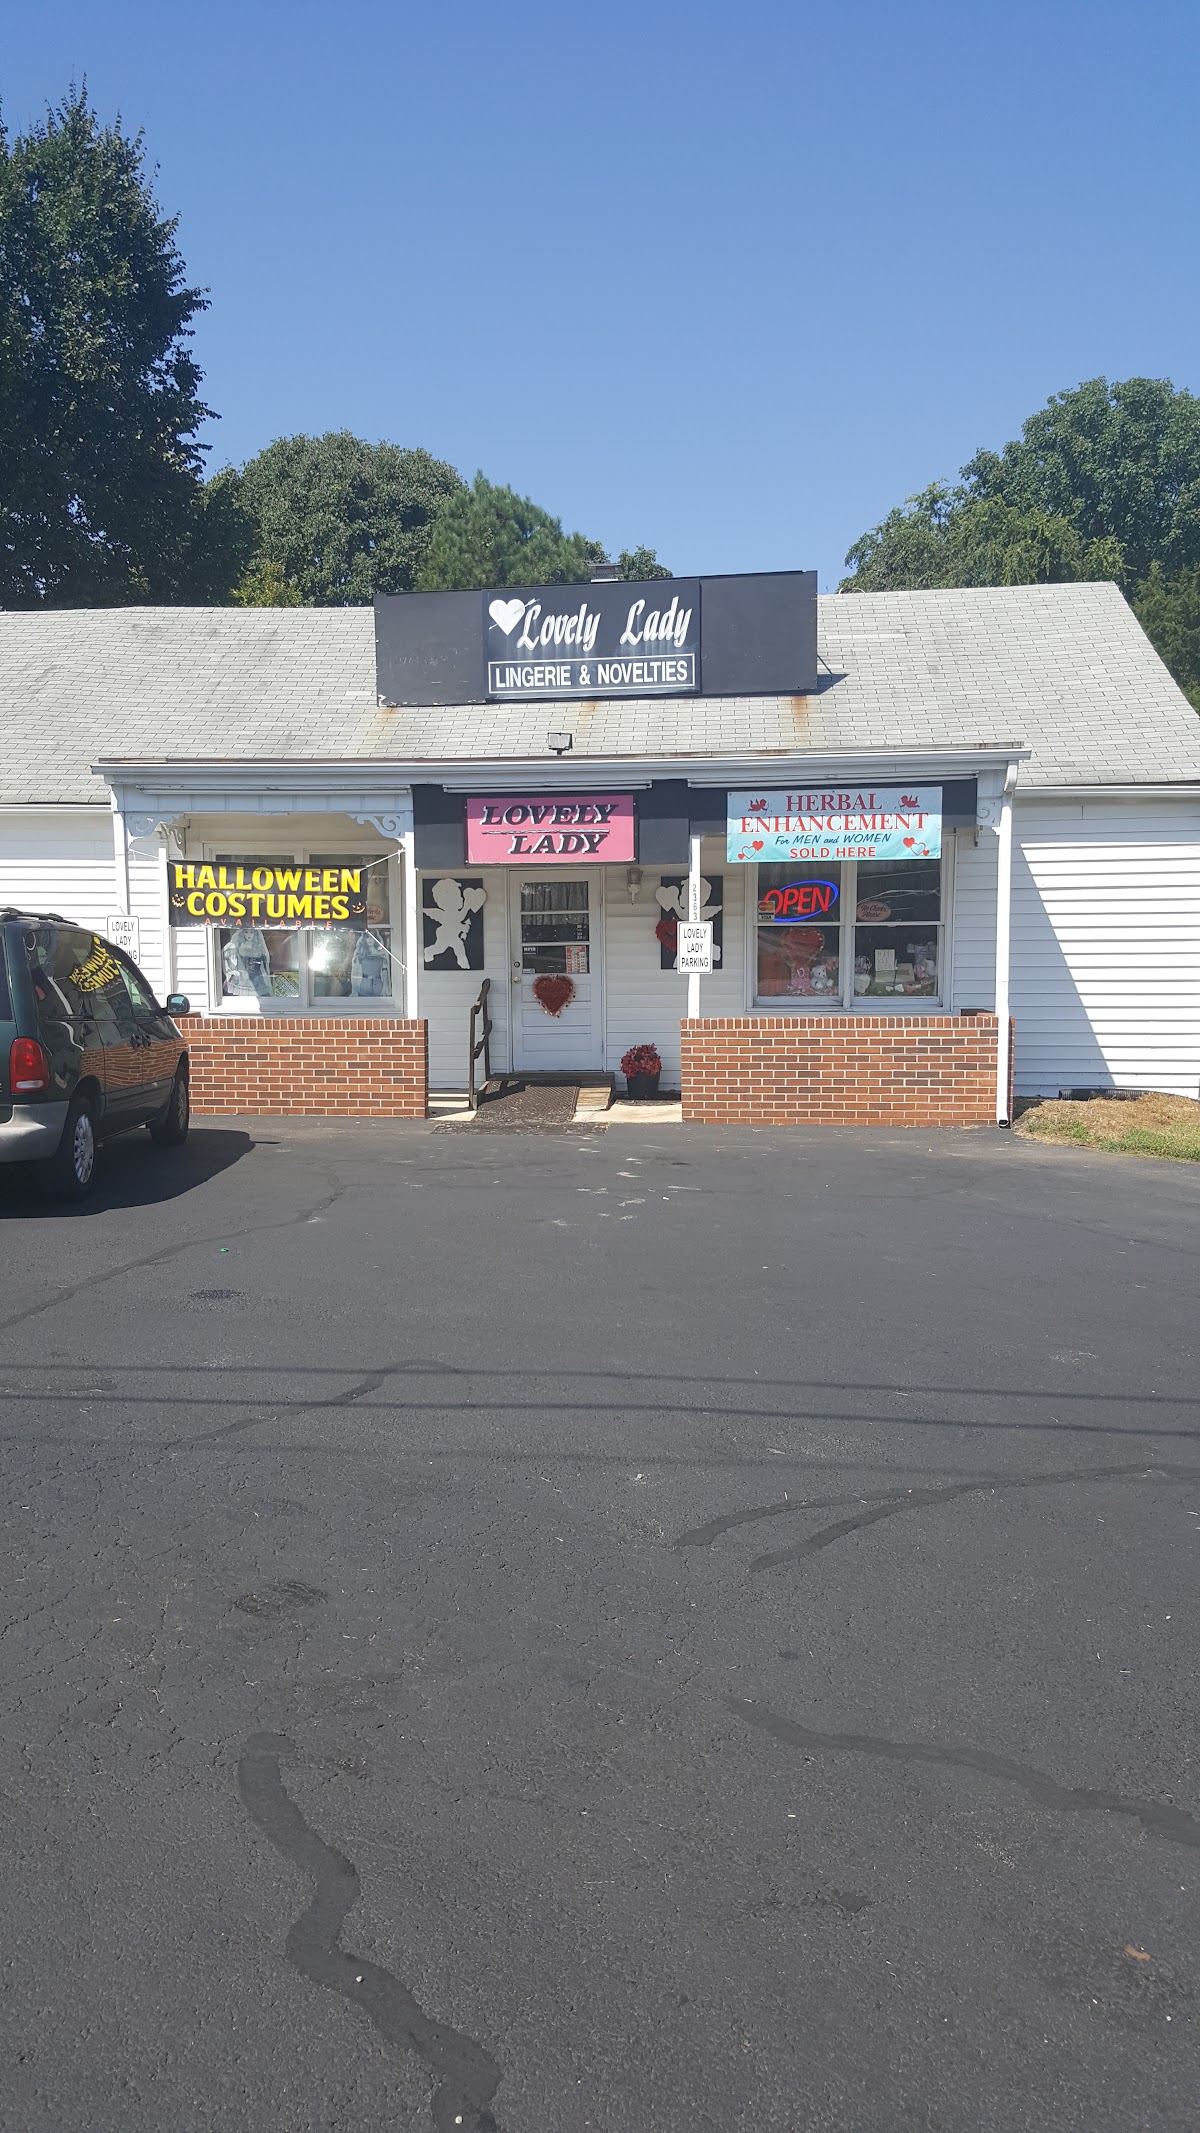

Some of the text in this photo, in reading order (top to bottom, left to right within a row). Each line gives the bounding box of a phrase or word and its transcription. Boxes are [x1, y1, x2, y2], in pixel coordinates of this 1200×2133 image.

[516, 596, 694, 652] Lovely Lady
[495, 660, 688, 689] LINGERIE & NOVELTIES
[785, 793, 883, 812] HERBAL
[481, 804, 618, 825] LOVELY
[740, 813, 929, 833] ENHANCEMENT
[508, 834, 607, 854] LADY
[775, 833, 892, 845] For MEN and WOMEN
[790, 846, 877, 858] SOLD HERE
[174, 864, 362, 894] HALLOWEEN
[186, 892, 351, 920] COSTUMES
[763, 887, 831, 915] OPEN
[112, 921, 135, 932] LOVELY
[204, 918, 333, 928] AVAILABLE
[116, 936, 132, 946] LADY
[683, 928, 707, 939] LOVELY
[686, 943, 704, 953] LADY
[681, 957, 709, 968] PARKING
